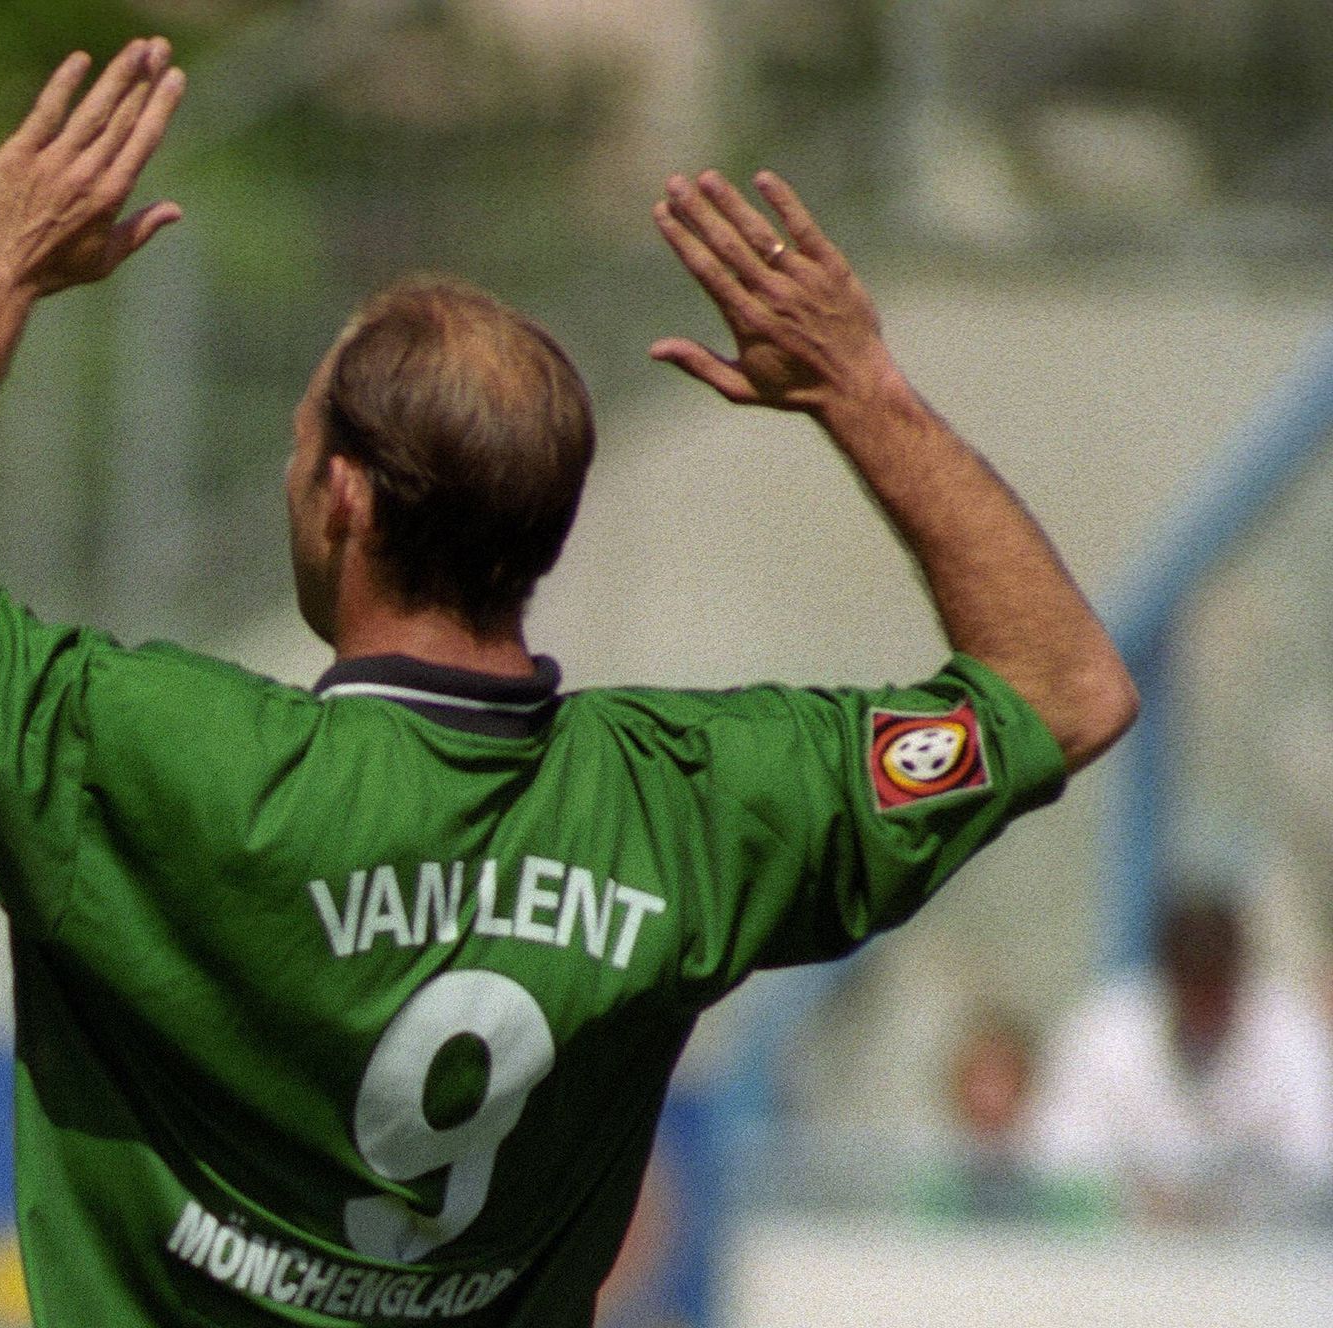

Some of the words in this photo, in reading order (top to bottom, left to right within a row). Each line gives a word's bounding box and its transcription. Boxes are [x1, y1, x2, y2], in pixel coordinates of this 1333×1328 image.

[307, 860, 465, 958] VAN
[473, 855, 668, 970] LENT
[343, 969, 556, 1264] 9
